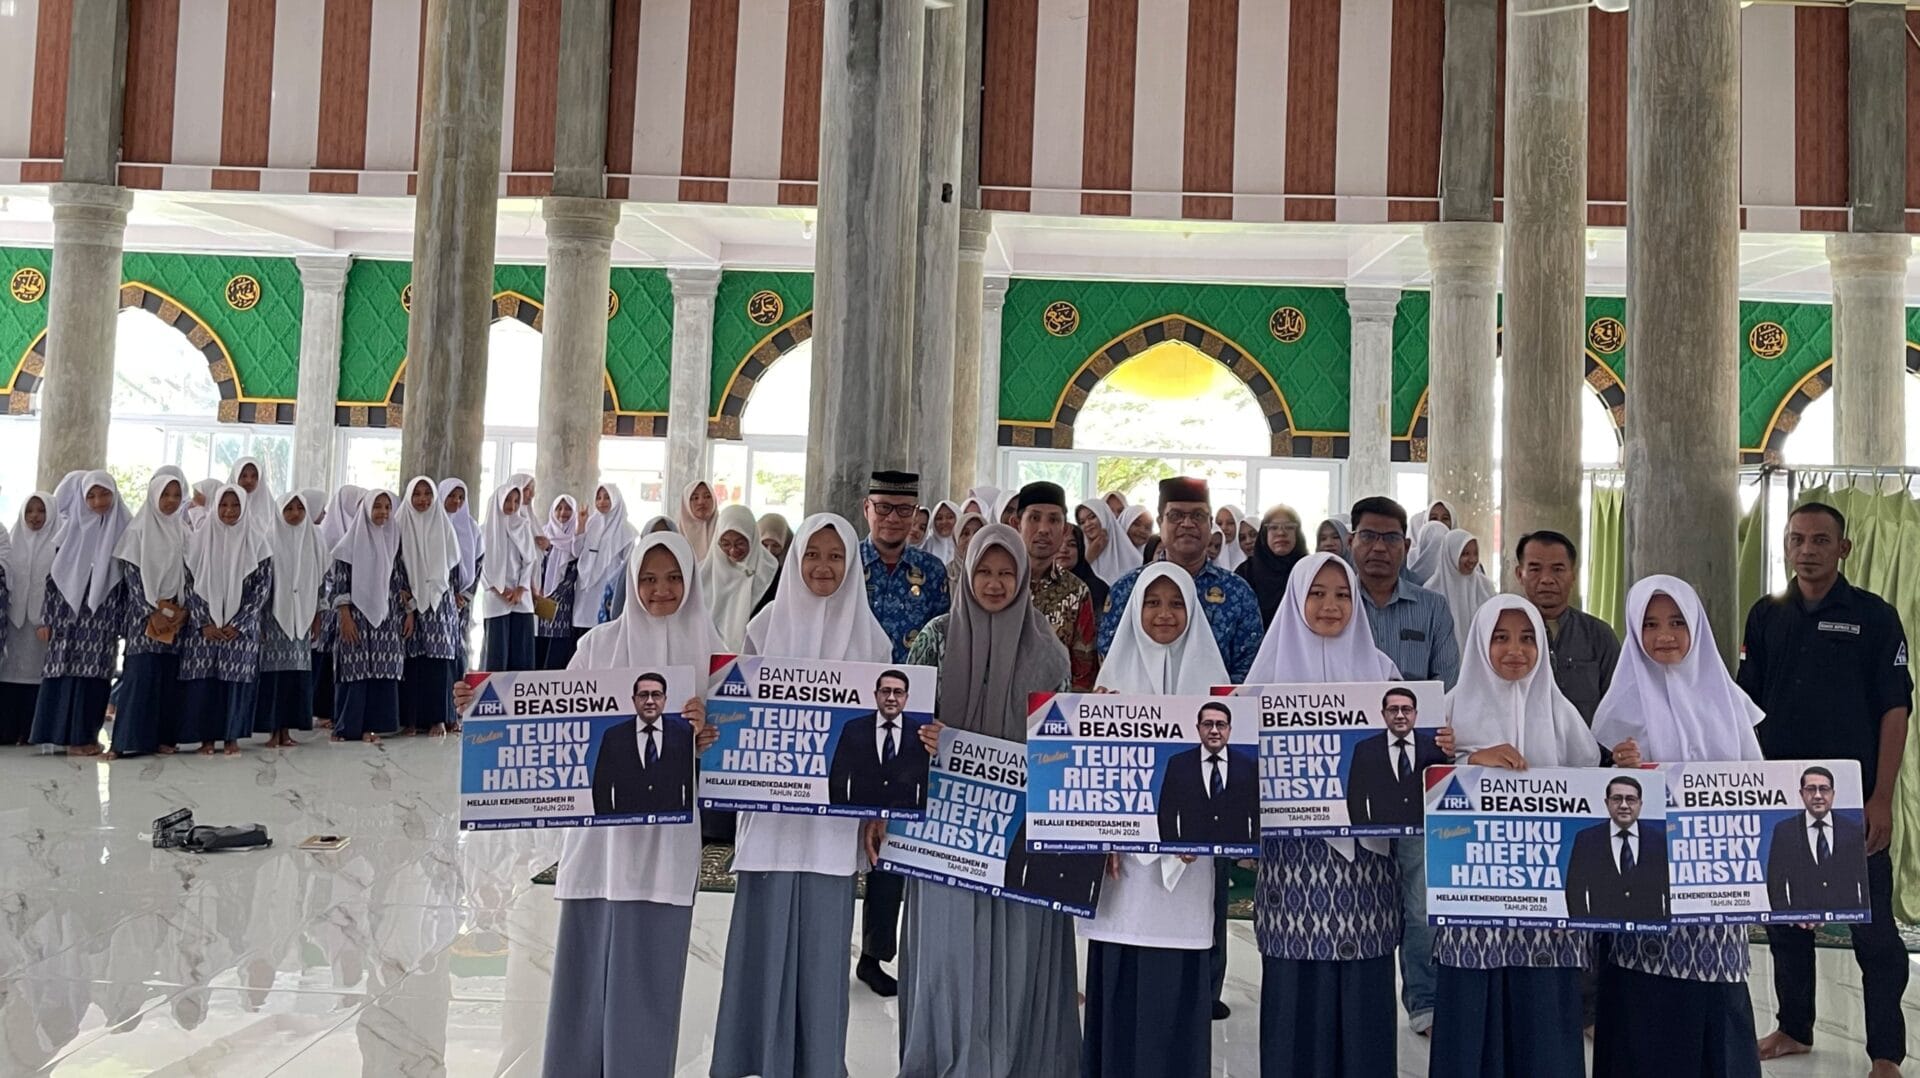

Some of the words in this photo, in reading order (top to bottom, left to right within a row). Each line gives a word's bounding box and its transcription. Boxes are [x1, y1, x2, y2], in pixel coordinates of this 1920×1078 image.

[760, 667, 841, 684] BANTUAN
[514, 680, 597, 697] BANTUAN
[723, 683, 747, 696] TRH
[758, 684, 861, 705] BEASISWA
[478, 701, 503, 716] TRH
[514, 696, 619, 715] BEASISWA
[1262, 694, 1345, 710] BANTUAN
[749, 707, 831, 731] TEUKU
[1080, 704, 1161, 720] BANTUAN
[1263, 711, 1369, 728] BEASISWA
[506, 721, 591, 745] TEUKU
[1043, 721, 1068, 734] TRH
[1079, 722, 1183, 739] BEASISWA
[739, 728, 829, 753] RIEFKY
[499, 743, 589, 767] RIEFKY
[722, 750, 827, 775] HARSYA
[1071, 746, 1155, 768] TEUKU
[483, 766, 590, 791] HARSYA
[949, 757, 1027, 787] BEASIS
[1064, 768, 1154, 790] RIEFKY
[1684, 773, 1764, 788] BANTUAN
[706, 778, 736, 786] MELALUI
[1260, 778, 1343, 800] ARSYA
[1481, 778, 1567, 794] BANTUAN
[794, 790, 810, 798] 2026
[938, 778, 1016, 815] TEUKU
[1049, 790, 1155, 813] HARSYA
[1444, 796, 1469, 809] TRH
[1684, 790, 1787, 807] BEASISWA
[467, 799, 498, 807] MELALUI
[1481, 796, 1591, 814] BEASISWA
[1099, 828, 1121, 836] TAHUN
[1474, 820, 1561, 843] TEUKU
[1678, 815, 1761, 837] TEUKU
[888, 840, 917, 853] MELALUI
[1466, 842, 1560, 865] RIEFKY
[1672, 837, 1761, 861] RIEFKY
[948, 862, 968, 872] TAHUN
[970, 868, 986, 877] 2026
[1451, 865, 1562, 888] HARSYA
[1437, 894, 1468, 902] MELALUI
